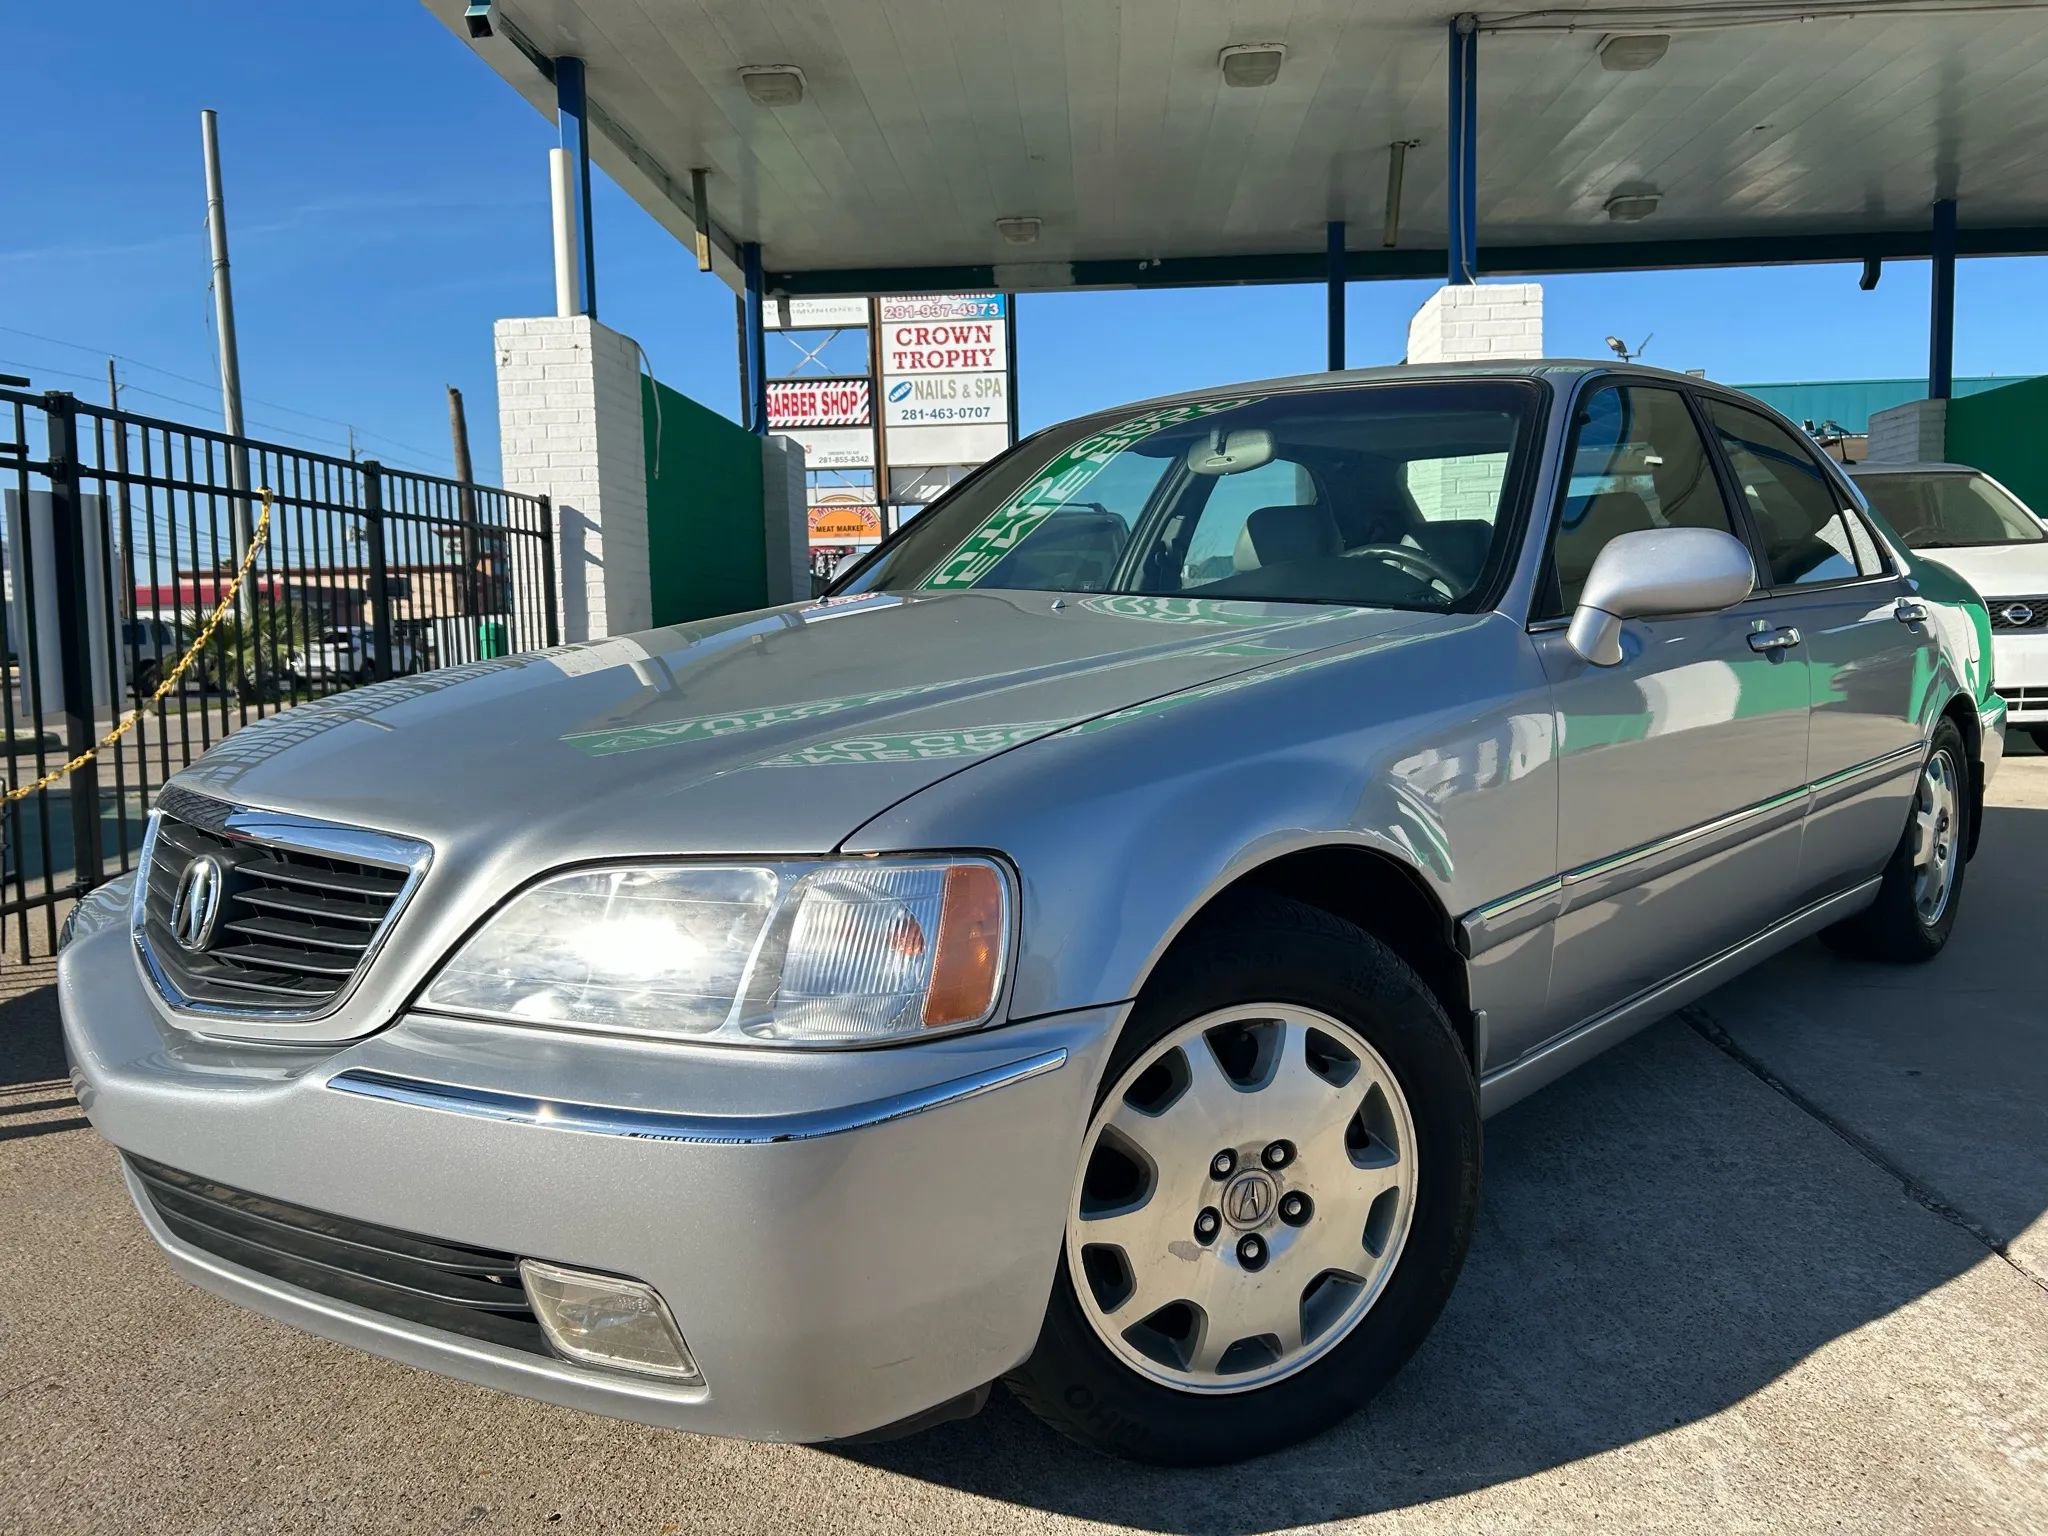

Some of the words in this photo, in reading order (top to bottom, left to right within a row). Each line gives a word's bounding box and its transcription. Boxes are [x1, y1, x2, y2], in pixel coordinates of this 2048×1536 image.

[884, 303, 999, 319] 281-937-4973
[896, 325, 992, 346] CROWN
[893, 348, 995, 369] TROPHY
[914, 379, 956, 400] NAILS
[962, 384, 971, 398] &
[975, 378, 1002, 398] SPA
[767, 392, 817, 417] BARBER
[822, 391, 858, 416] SHOP
[902, 407, 990, 420] 281-463-0707
